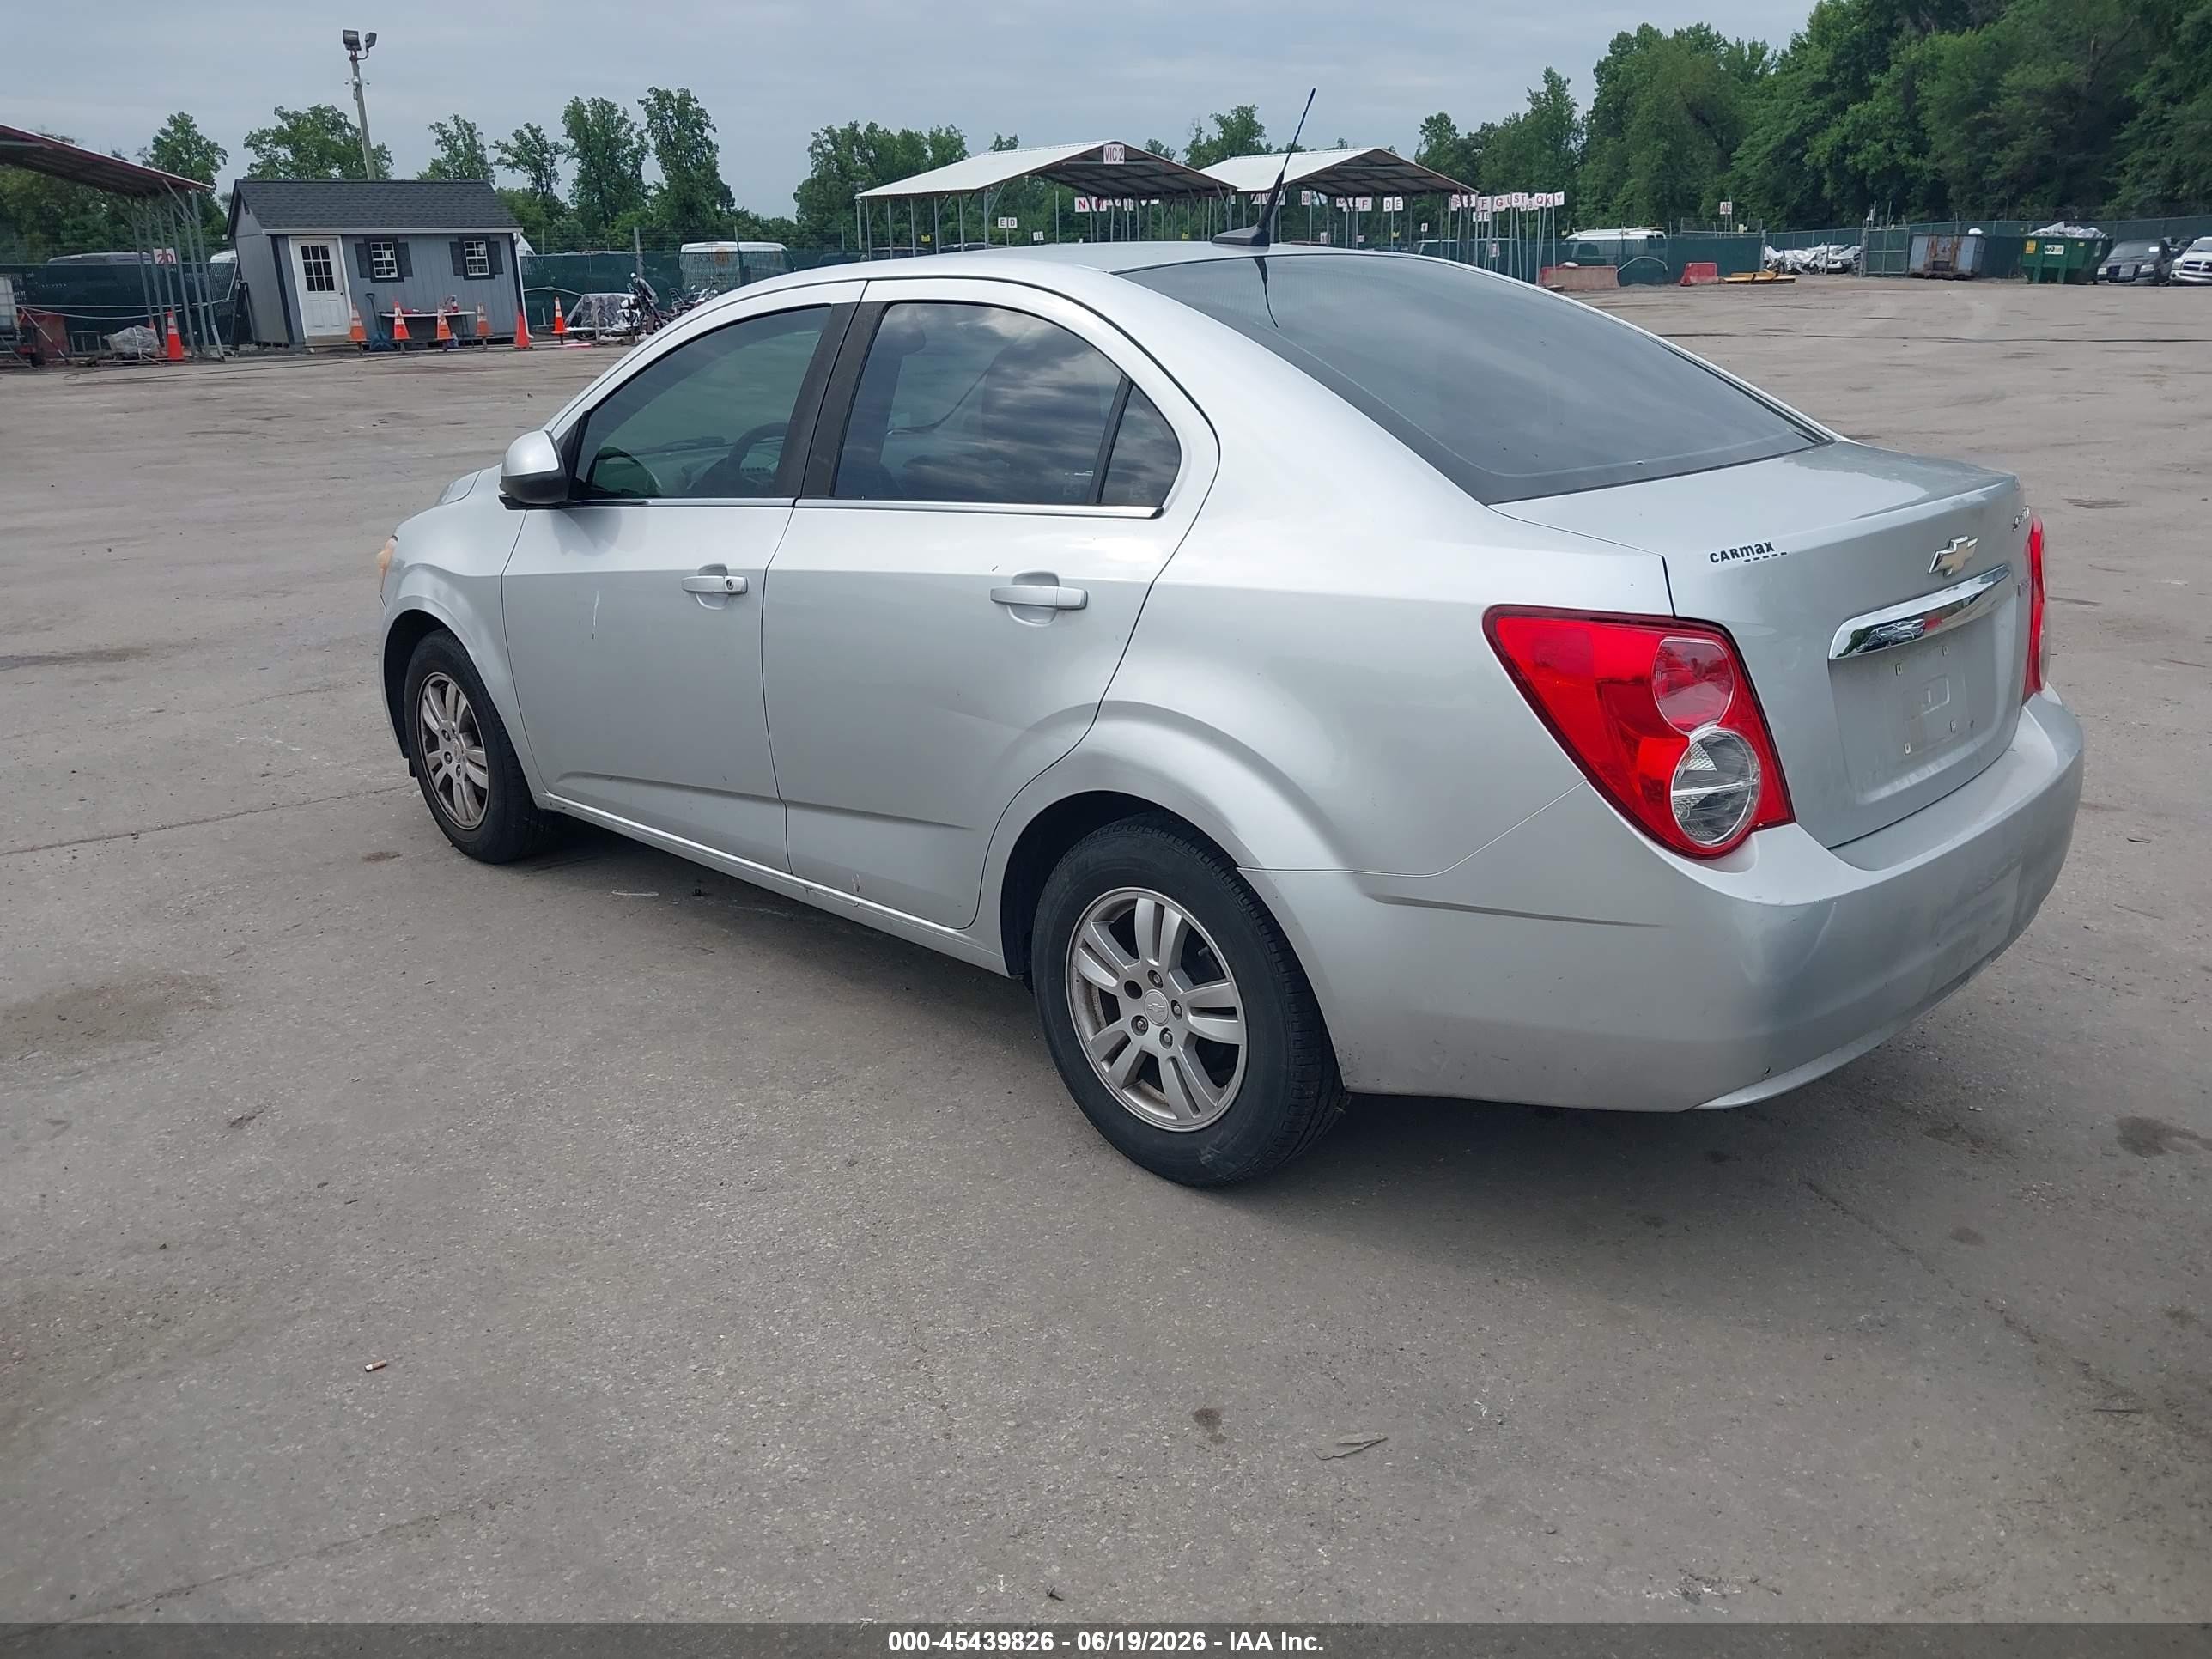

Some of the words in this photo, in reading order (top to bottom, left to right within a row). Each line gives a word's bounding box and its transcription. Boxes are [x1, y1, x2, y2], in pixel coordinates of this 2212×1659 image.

[1104, 147, 1117, 161] VIC
[1118, 147, 1124, 161] 2
[1302, 193, 1310, 204] 20
[1395, 198, 1401, 209] E
[1496, 198, 1504, 207] G
[1514, 194, 1520, 204] S
[1536, 195, 1544, 204] Q
[1556, 194, 1562, 203] Y
[1079, 199, 1086, 210] N
[1362, 199, 1368, 210] F
[1385, 200, 1391, 210] D
[1000, 218, 1006, 227] E
[1010, 218, 1016, 227] D
